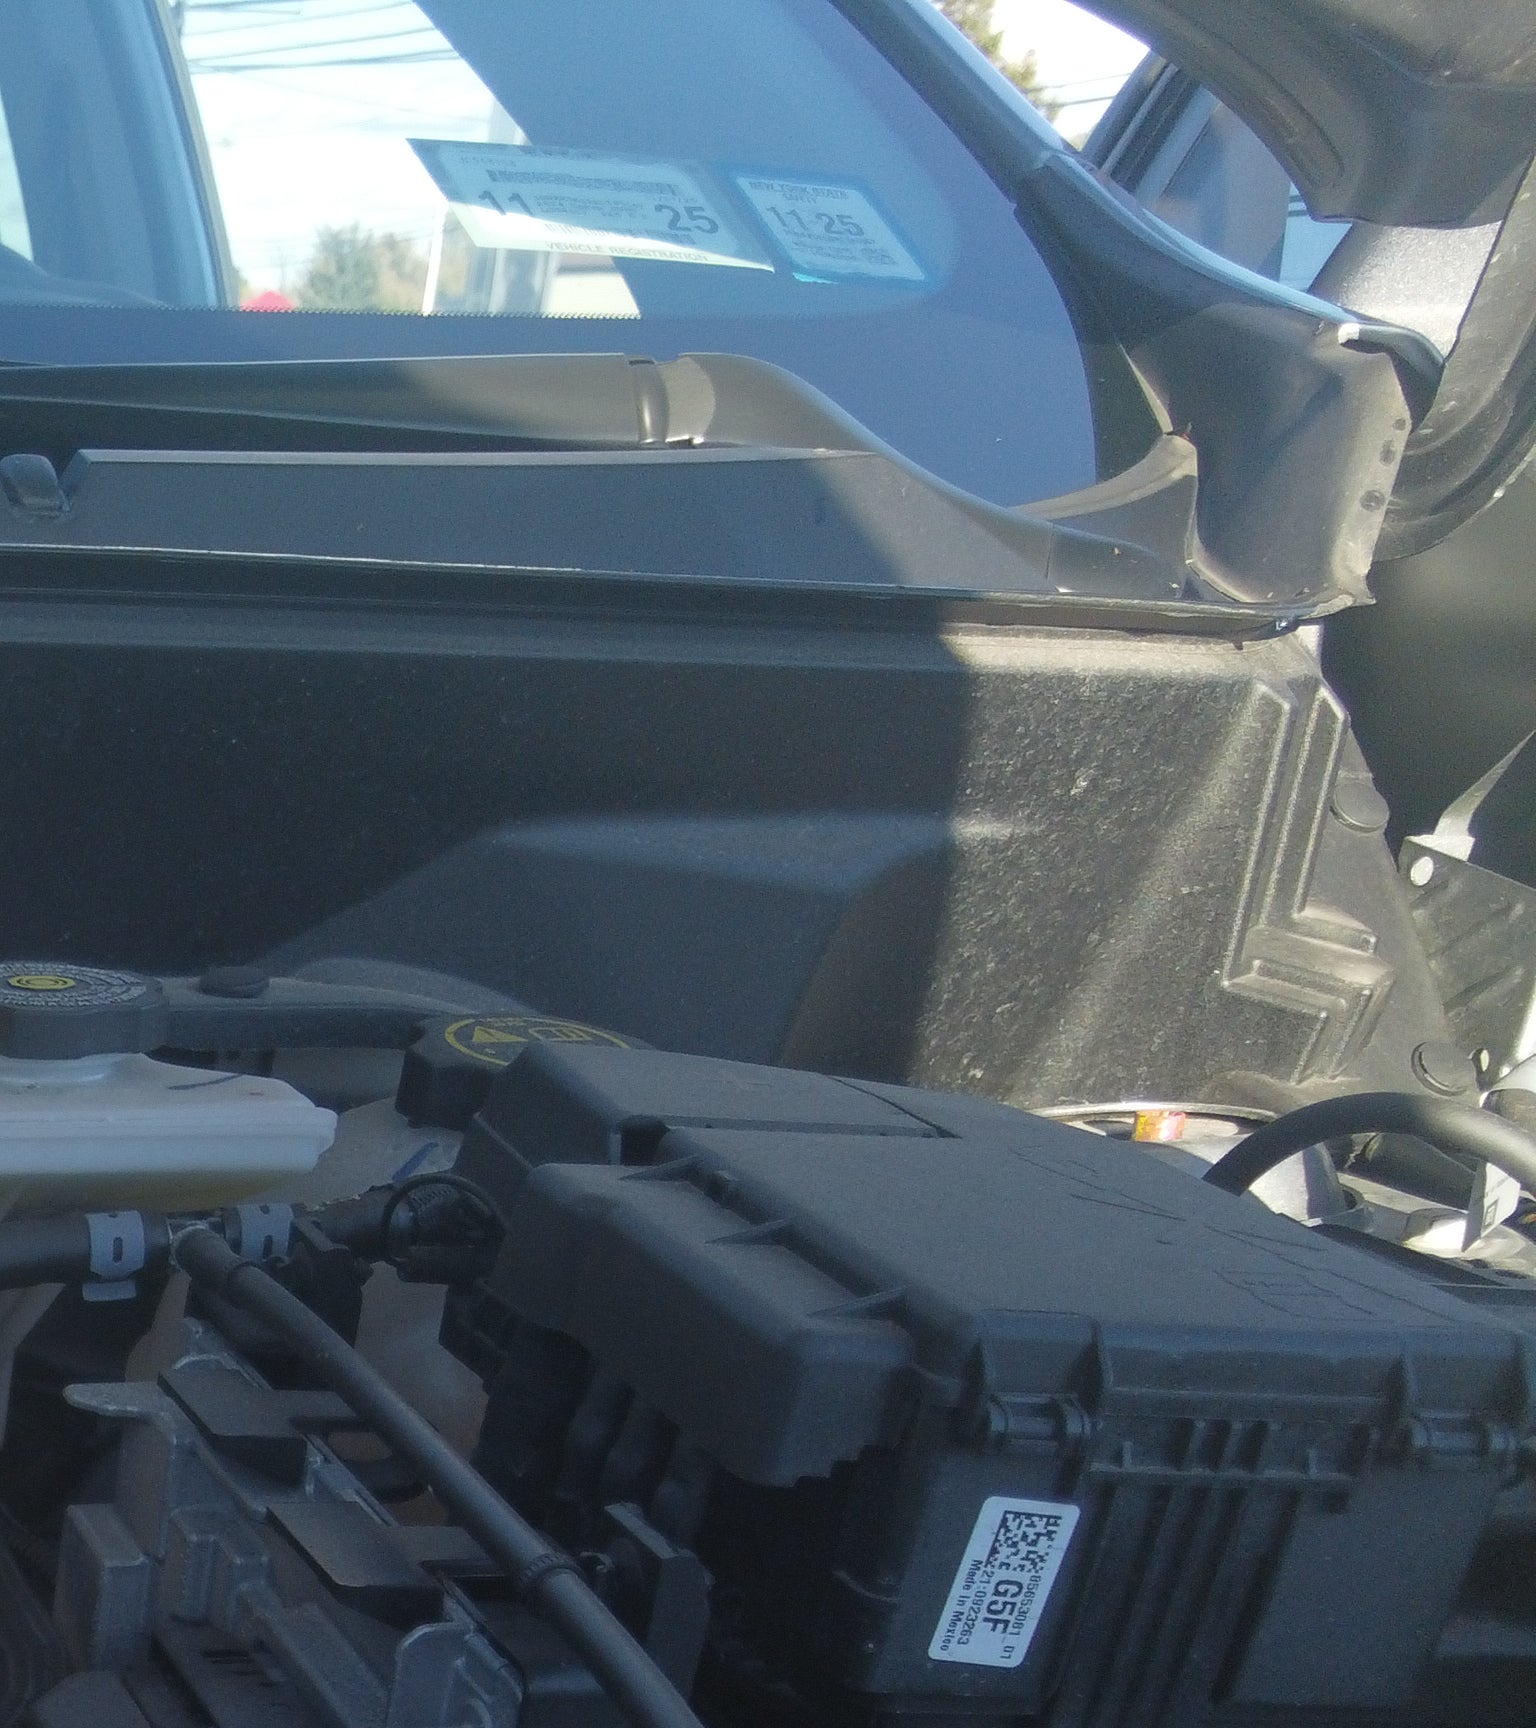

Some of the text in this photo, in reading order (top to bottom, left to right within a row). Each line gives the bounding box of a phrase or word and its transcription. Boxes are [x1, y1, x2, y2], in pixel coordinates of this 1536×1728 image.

[479, 190, 533, 216] 11
[654, 204, 719, 234] 25
[766, 206, 865, 236] 11 25
[547, 241, 709, 261] VEHICLE REGISTRATION
[963, 1559, 983, 1591] Made
[983, 1579, 1024, 1634] G5F
[940, 1610, 964, 1651] Mexico
